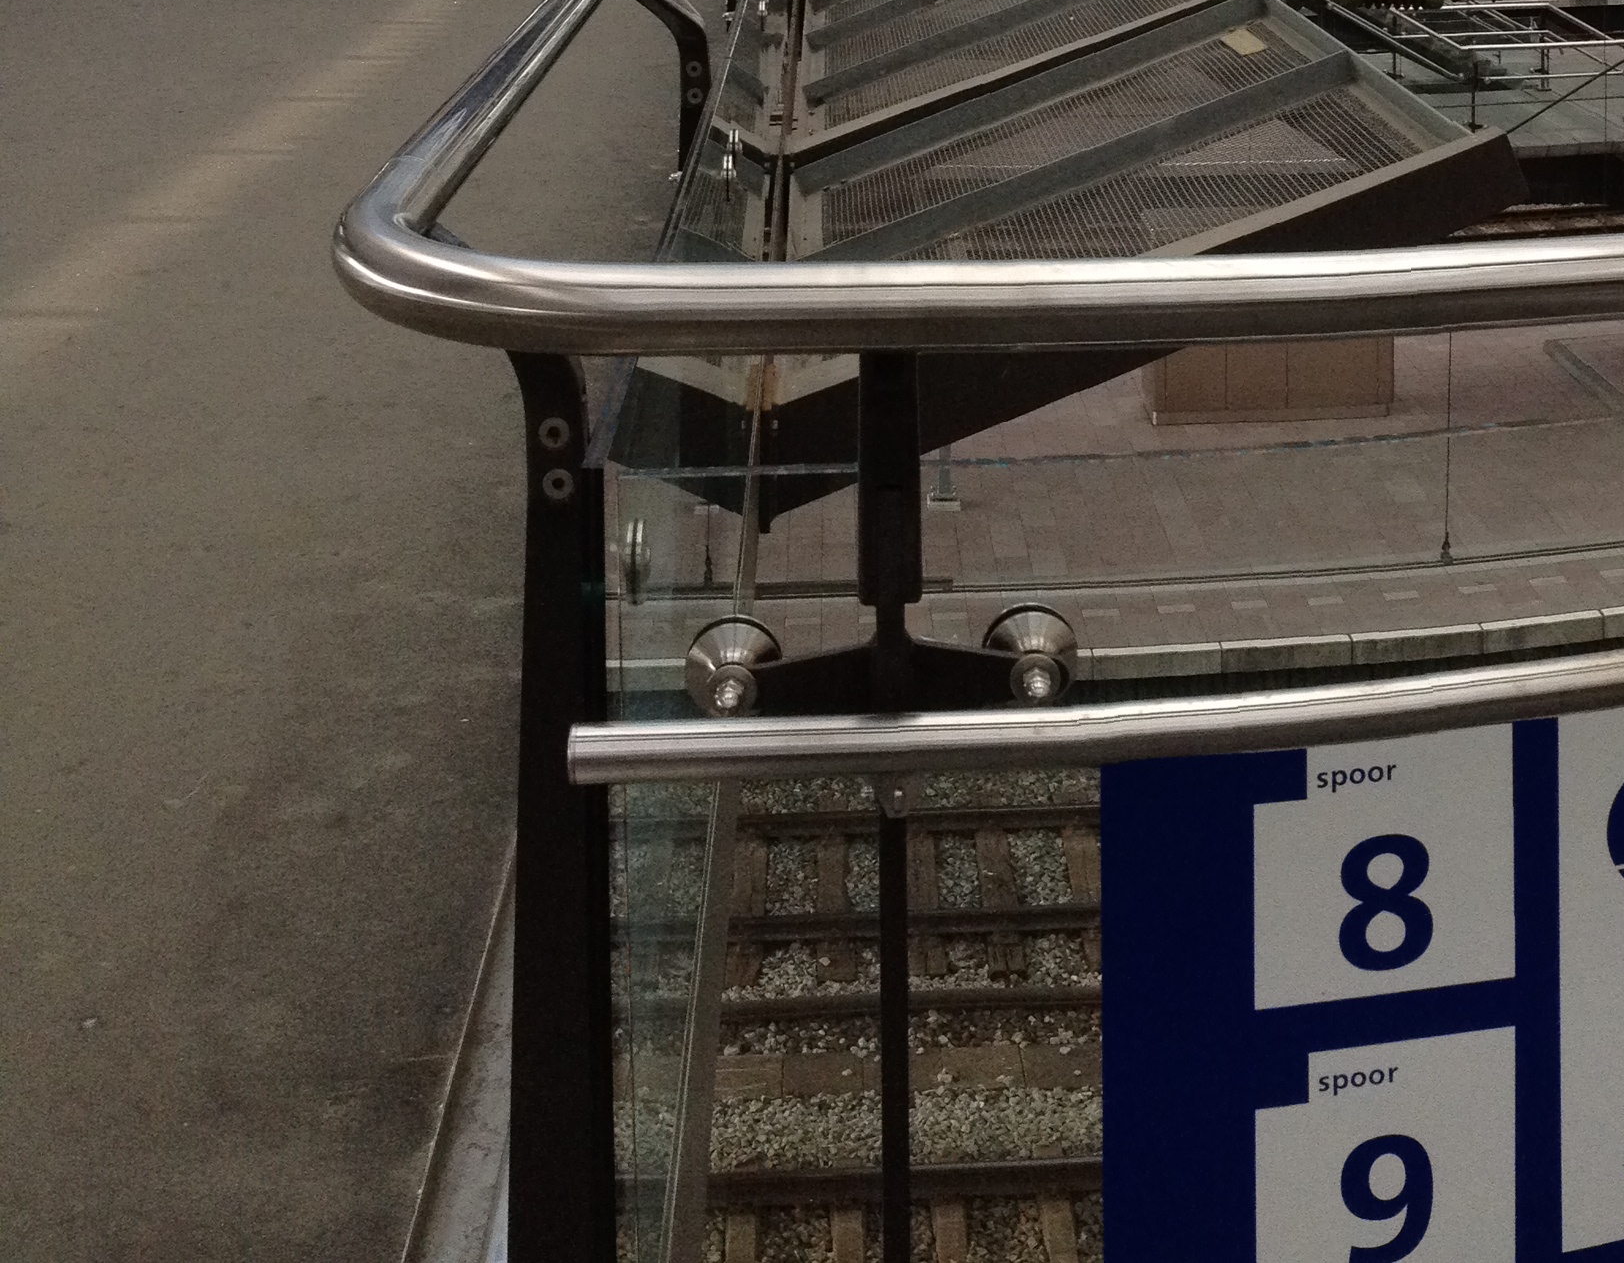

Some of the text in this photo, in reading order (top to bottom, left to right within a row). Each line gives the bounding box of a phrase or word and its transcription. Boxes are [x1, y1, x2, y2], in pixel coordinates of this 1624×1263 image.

[1315, 759, 1398, 792] spoor
[1336, 833, 1435, 972] 8
[1316, 1062, 1401, 1097] spoor
[1339, 1133, 1434, 1263] 9
